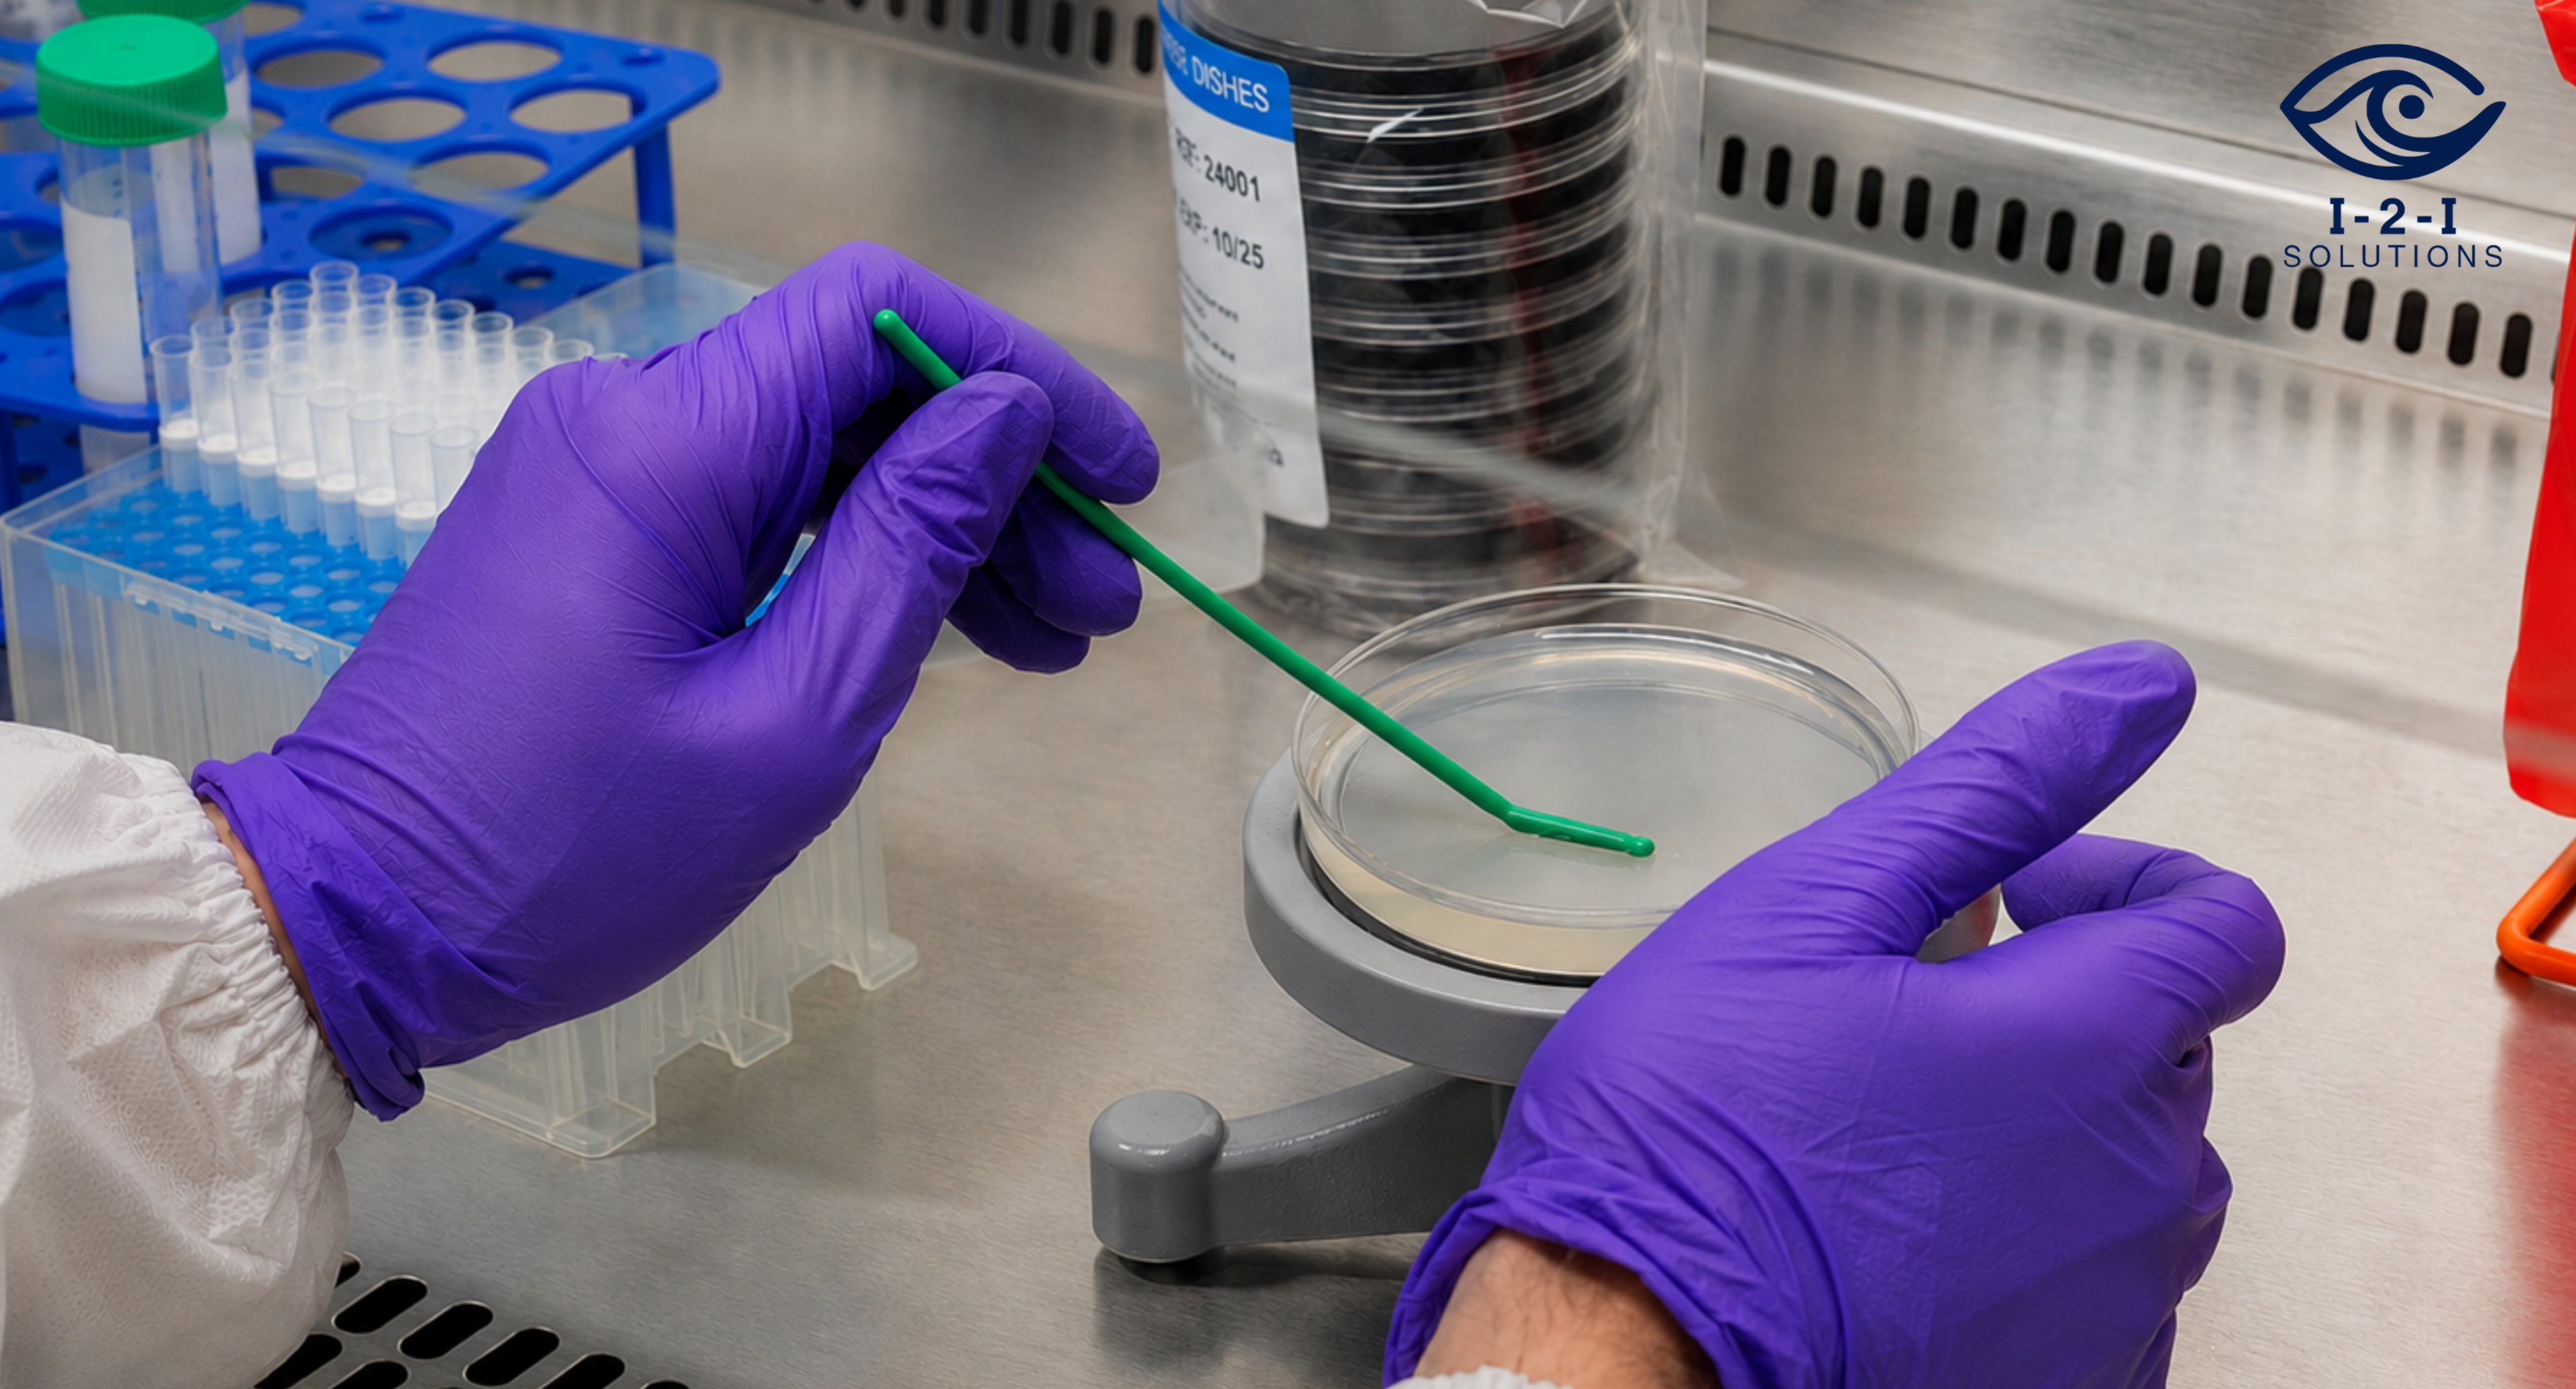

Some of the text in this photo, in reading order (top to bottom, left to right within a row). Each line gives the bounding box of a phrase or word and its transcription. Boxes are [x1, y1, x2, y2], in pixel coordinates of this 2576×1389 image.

[1191, 55, 1270, 113] DISHES
[1204, 154, 1260, 202] 24001
[1212, 226, 1264, 270] 10/25
